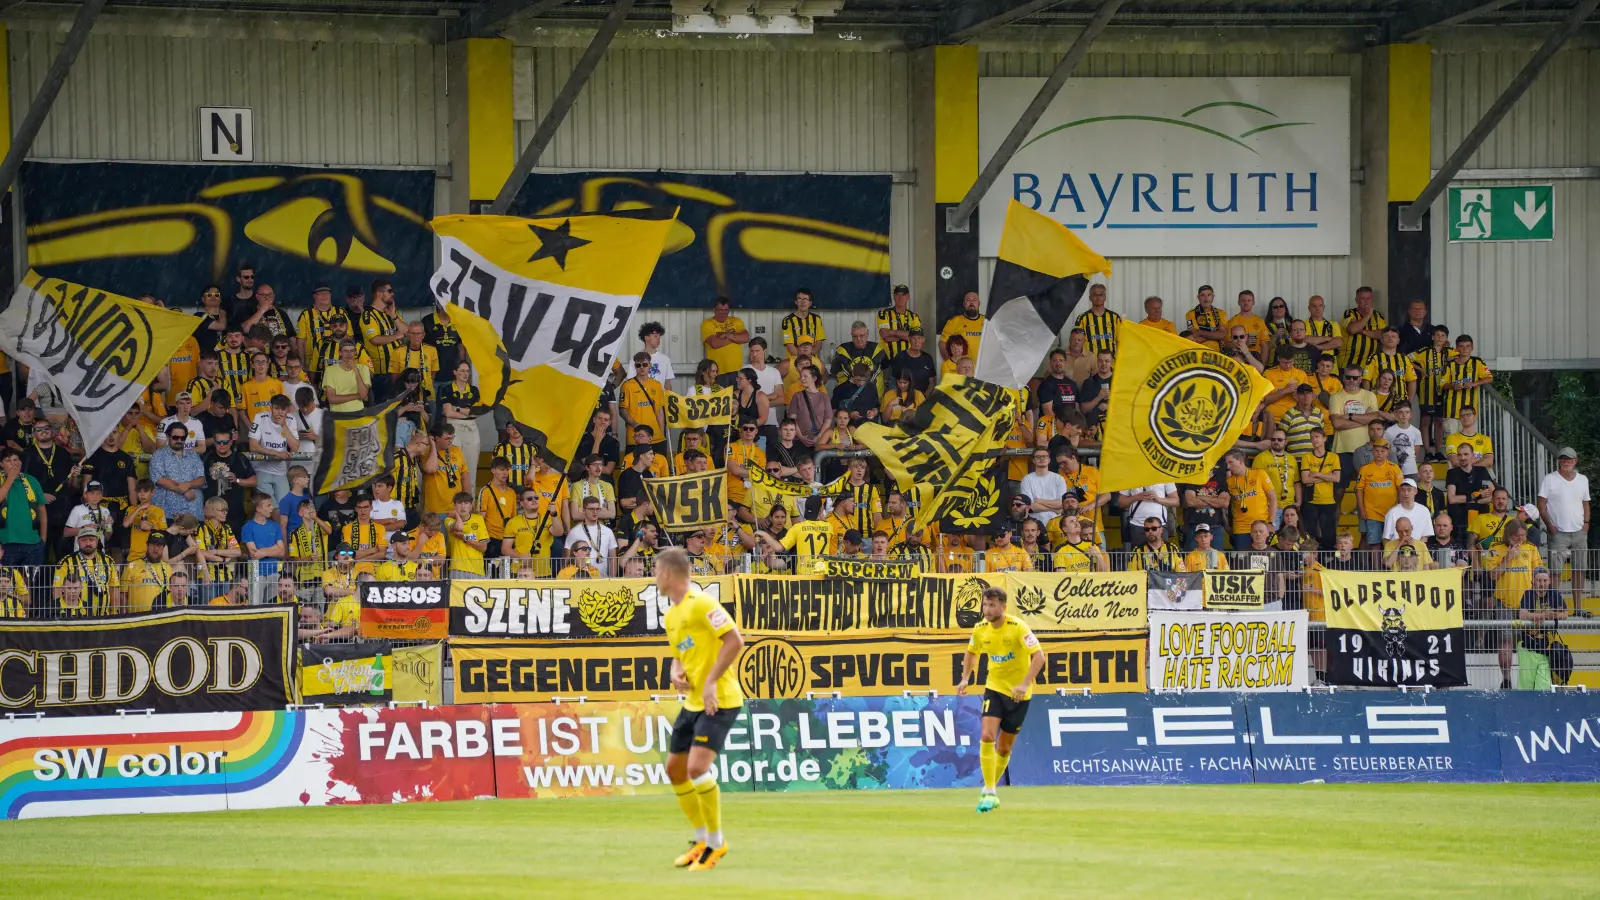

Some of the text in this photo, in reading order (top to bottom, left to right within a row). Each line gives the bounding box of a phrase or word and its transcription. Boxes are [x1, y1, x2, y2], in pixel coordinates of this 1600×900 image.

[211, 112, 242, 154] N
[1013, 172, 1318, 229] BAYREUTH
[668, 395, 679, 423] §
[648, 477, 724, 523] WSK
[804, 532, 828, 559] 12
[827, 562, 914, 580] SUPCREW
[1054, 576, 1138, 601] Collettivo
[1212, 576, 1256, 594] USK
[366, 586, 442, 604] ASSOS
[464, 586, 572, 634] SZENE
[738, 578, 954, 631] WAGNERSTADT KOLLEKTIV
[1055, 600, 1140, 624] Giallo Nero
[1209, 594, 1260, 602] ABSCHAFFEN
[1160, 621, 1296, 656] LOVE FOOTBALL
[1339, 634, 1452, 654] 19 21
[460, 656, 674, 692] GEGENGERA
[744, 644, 798, 698] SPVGG
[810, 653, 930, 688] SPVGG
[1163, 652, 1294, 689] HATE RACISM
[1352, 656, 1440, 682] VIKINGS
[358, 709, 970, 760] FARBE IST UNER LEBEN.
[1514, 718, 1600, 764] IMM
[33, 745, 226, 780] SW color
[1053, 756, 1183, 773] RECHTSANWÄLTE
[1200, 755, 1316, 772] FACHANWÄLTE
[1333, 756, 1454, 770] STEUERBERATER
